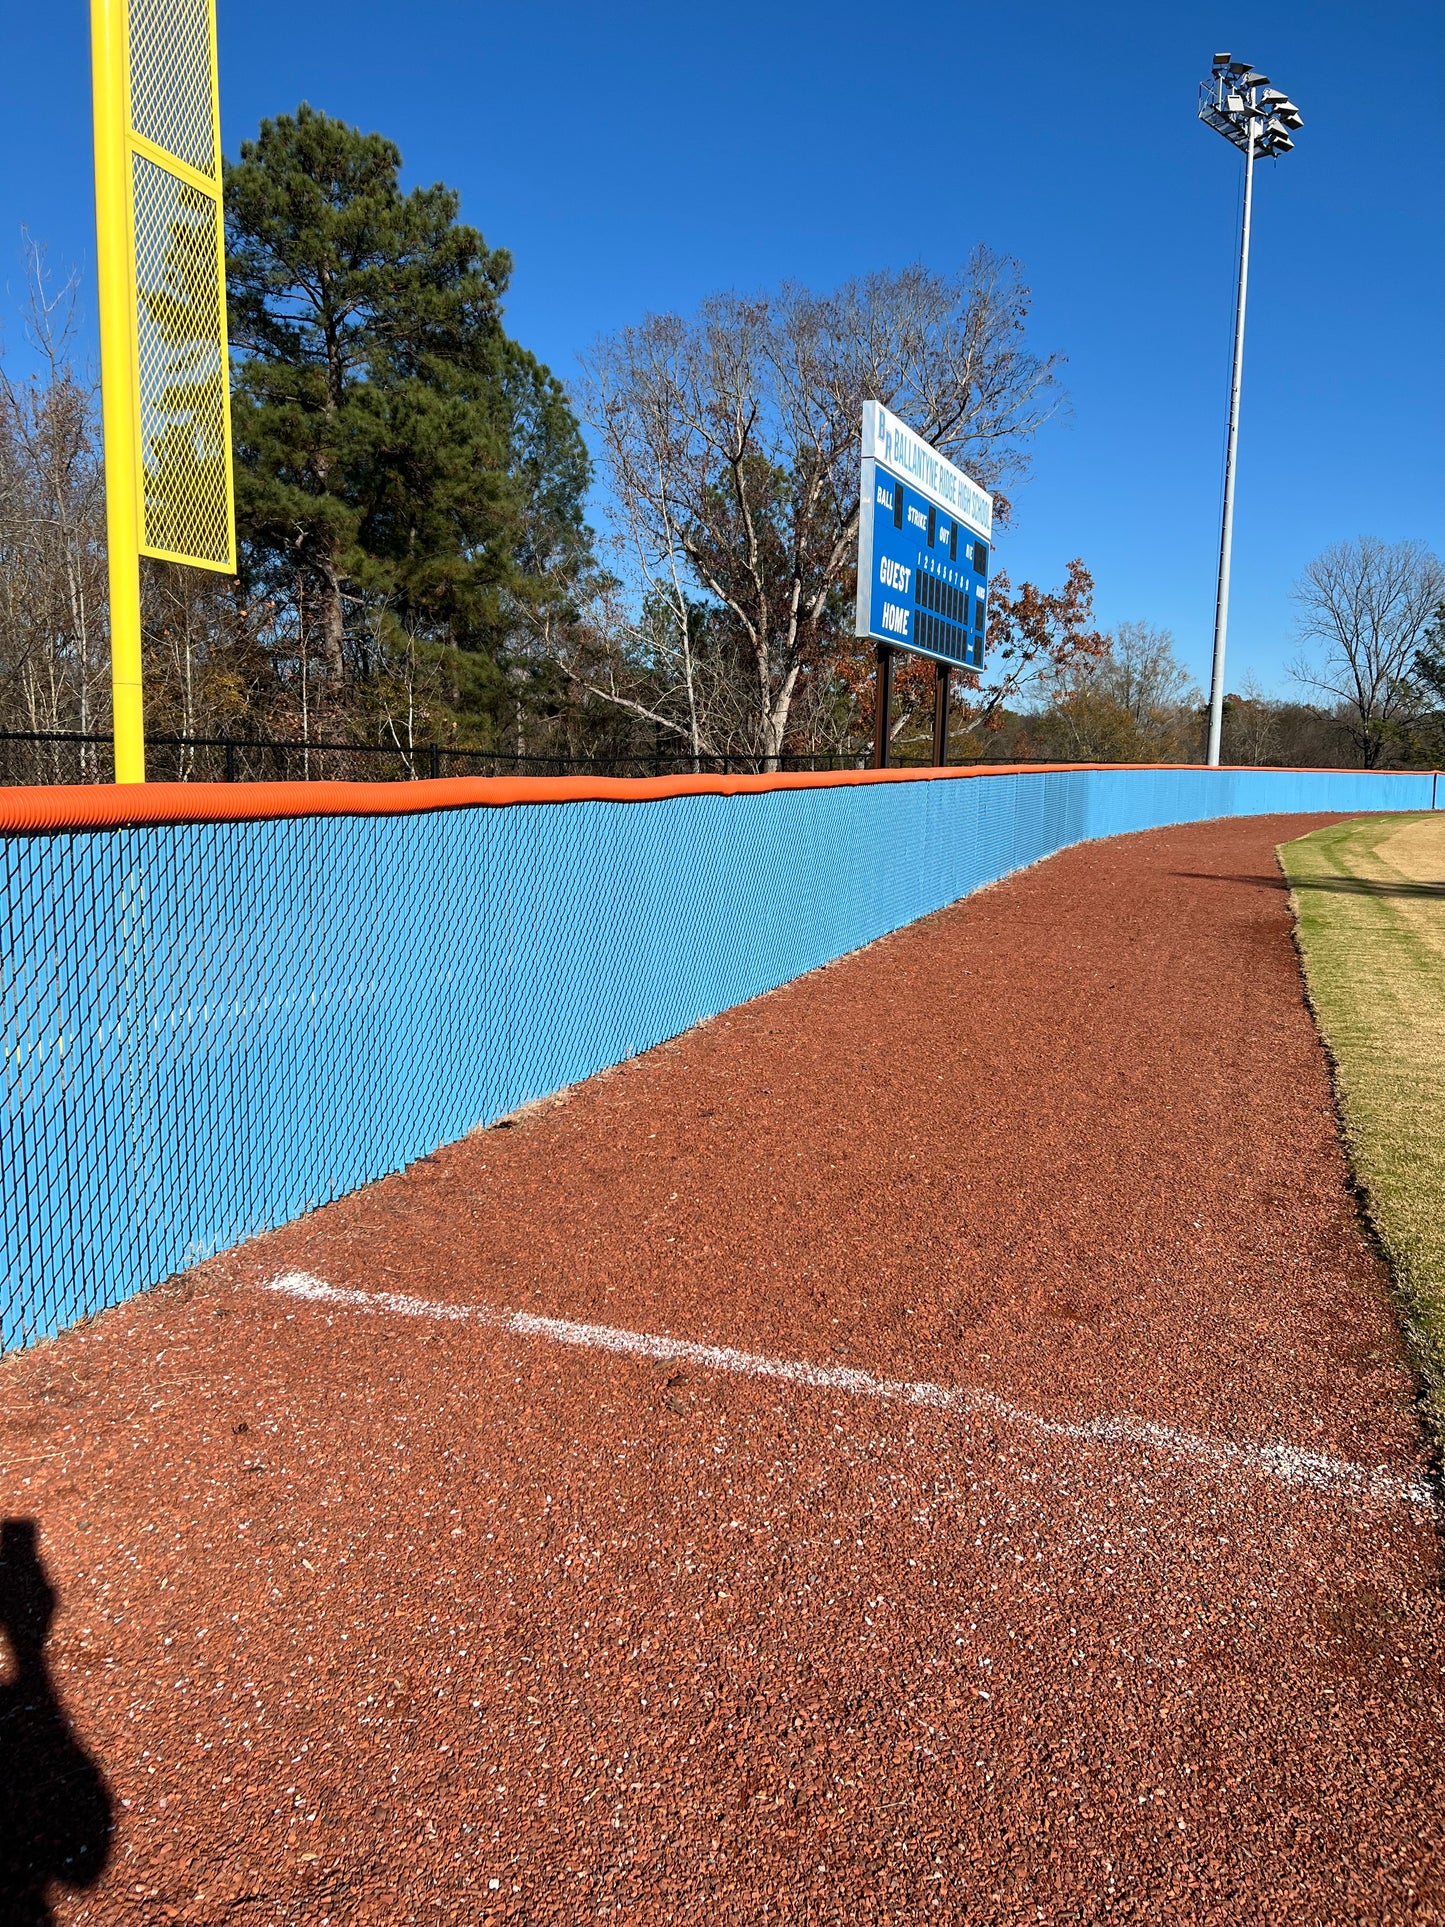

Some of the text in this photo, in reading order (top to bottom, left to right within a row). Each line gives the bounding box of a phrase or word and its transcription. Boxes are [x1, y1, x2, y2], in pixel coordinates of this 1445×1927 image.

[894, 428, 991, 531] BALLANTYNE RIDGE HIGH SCHOOL
[877, 485, 893, 511] BALL
[907, 505, 928, 531] STRIKE
[939, 526, 950, 545] OUT
[880, 555, 912, 594] GUEST
[917, 551, 970, 591] 1 2 3 4 5 6 7 8 9
[881, 601, 910, 636] HOME
